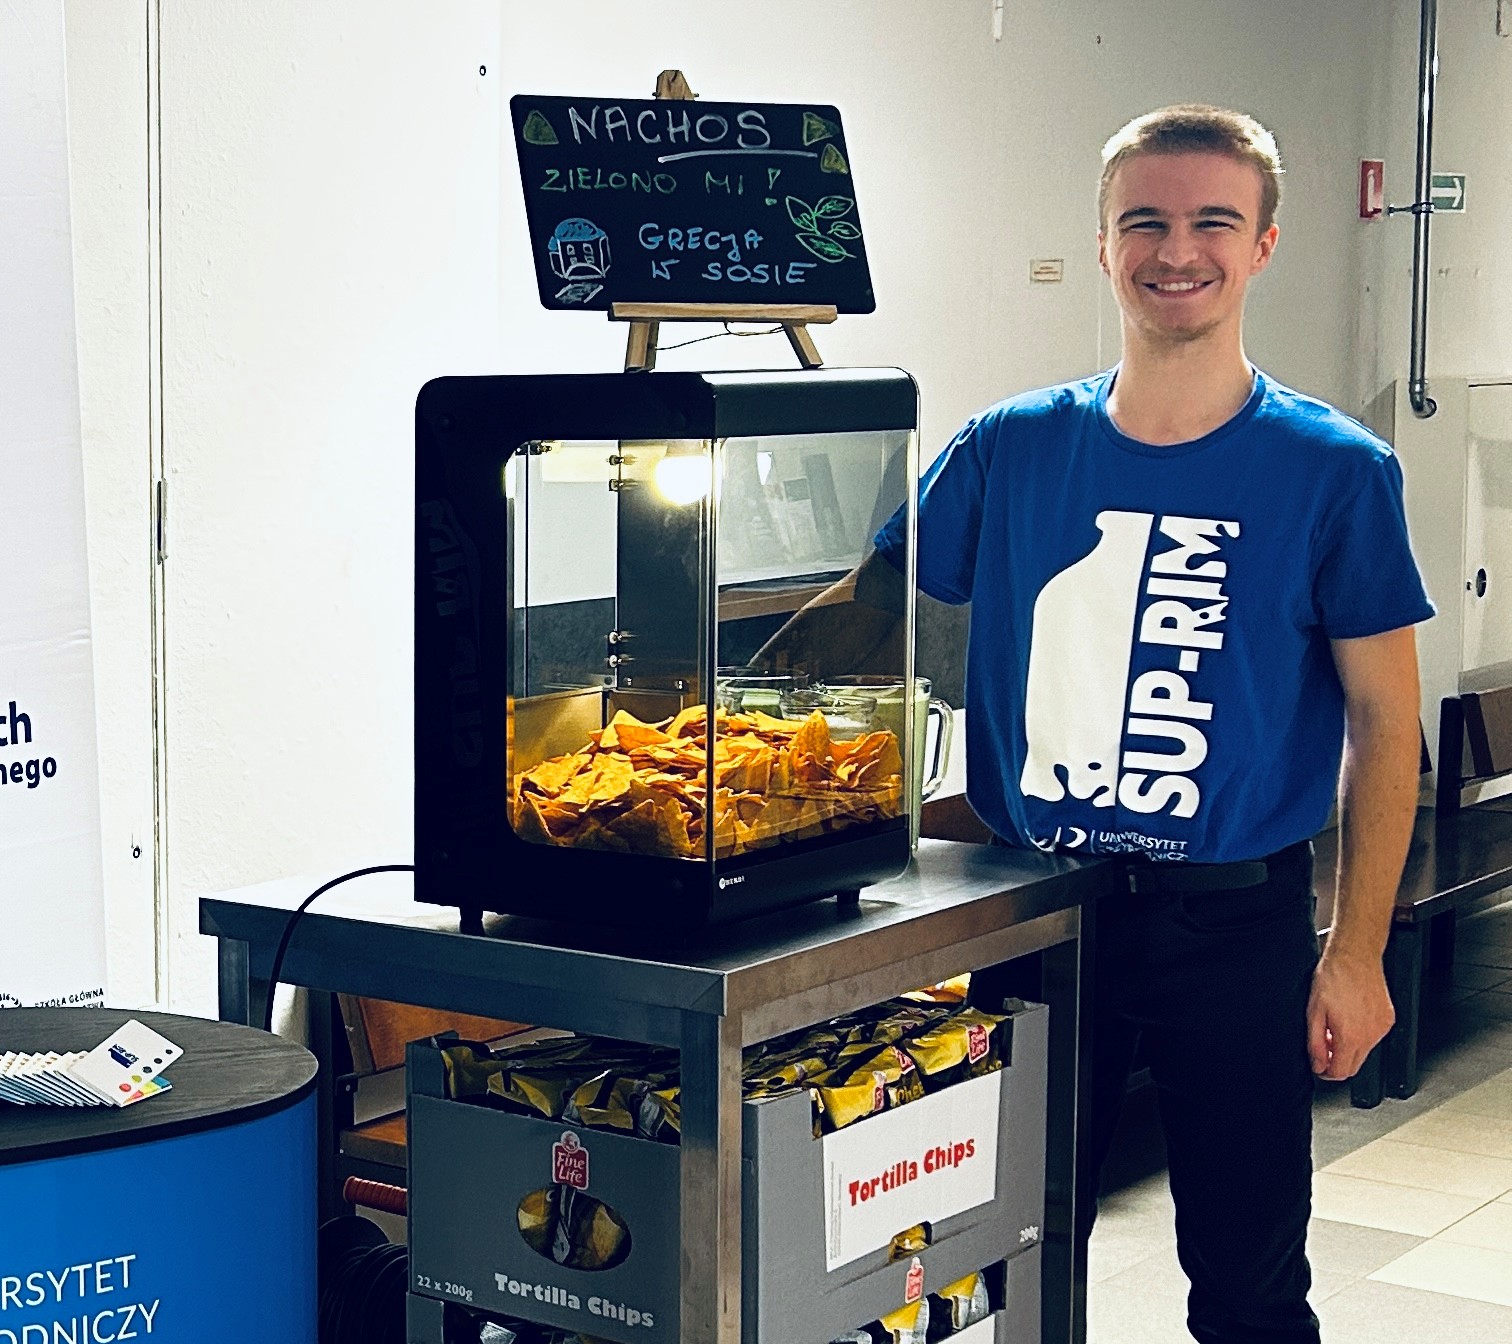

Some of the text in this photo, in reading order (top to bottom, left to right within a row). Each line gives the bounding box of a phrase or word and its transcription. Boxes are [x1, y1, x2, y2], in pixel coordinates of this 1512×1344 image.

[568, 105, 771, 149] NACHOS
[540, 167, 677, 194] ZIELONO
[705, 169, 744, 195] MI
[701, 261, 818, 285] SOSIE
[1117, 515, 1240, 819] SUP-RIM
[556, 1151, 585, 1169] Fine
[847, 1137, 976, 1207] Tortilla Chips
[558, 1165, 583, 1184] Life
[416, 1274, 474, 1302] 22 x 200g
[493, 1272, 655, 1328] Tortilla Chips
